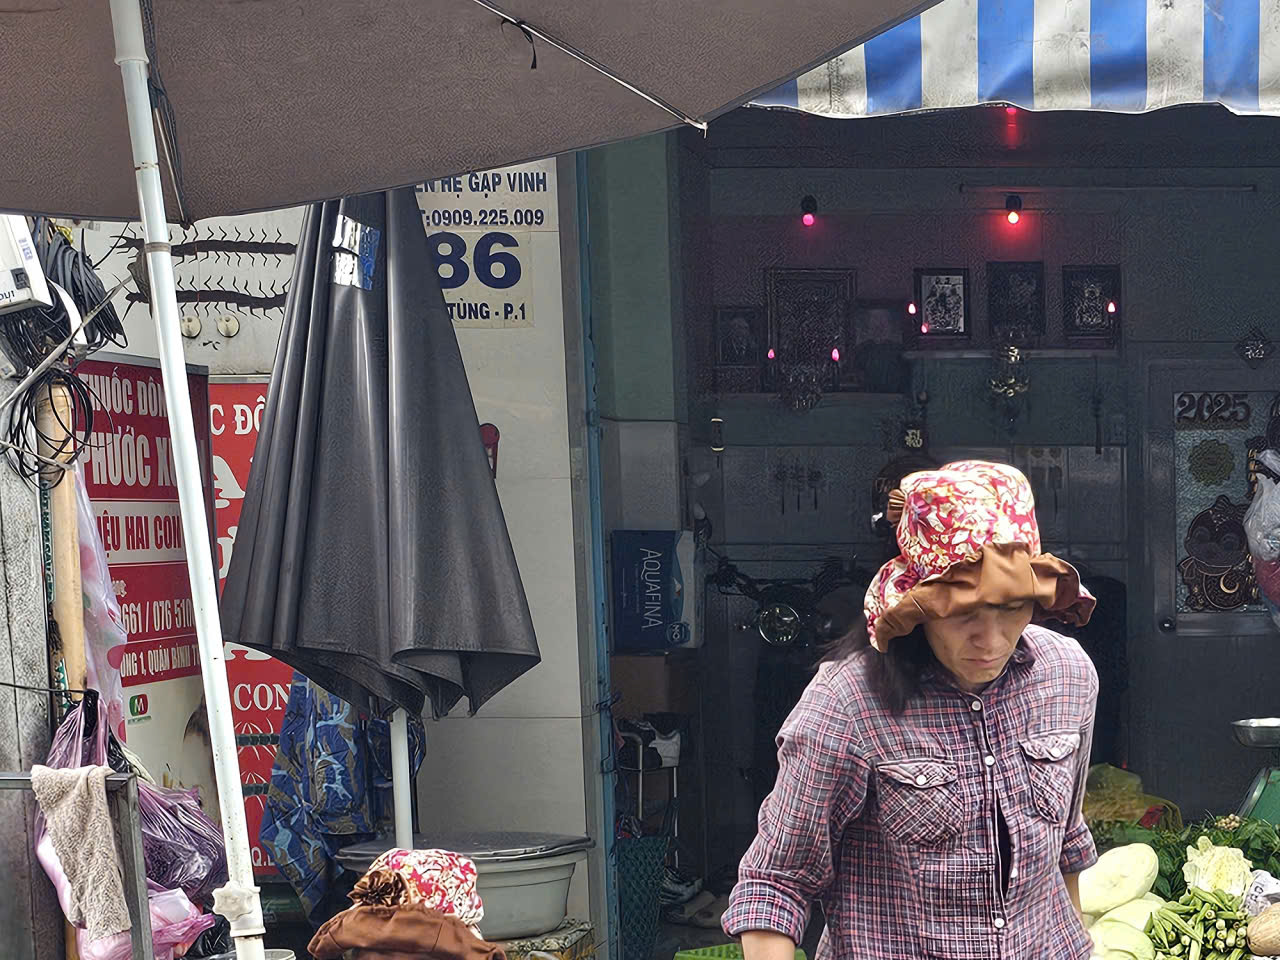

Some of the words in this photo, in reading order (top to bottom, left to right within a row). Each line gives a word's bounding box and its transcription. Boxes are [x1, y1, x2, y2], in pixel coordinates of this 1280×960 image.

[507, 172, 547, 192] VINH
[504, 303, 525, 320] P.1
[125, 515, 149, 550] HAI
[640, 547, 664, 630] AQUAFINA
